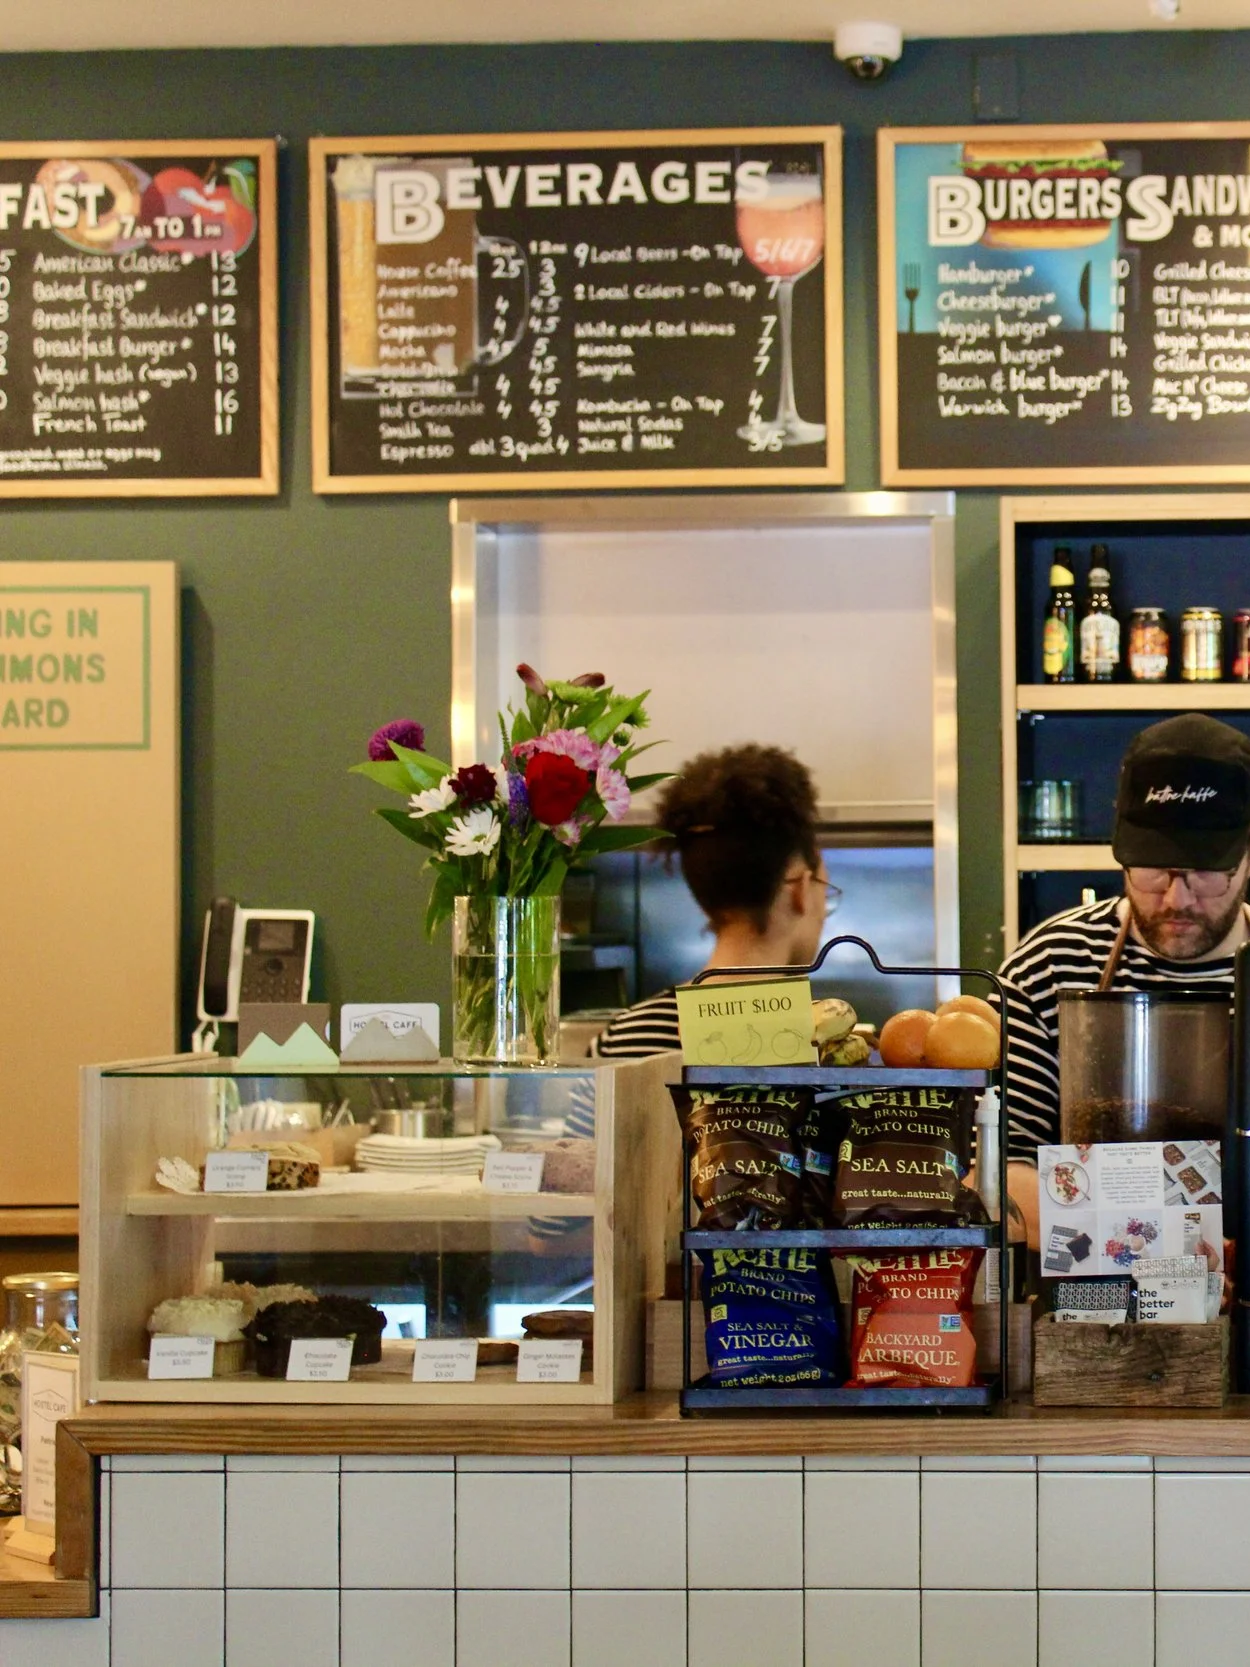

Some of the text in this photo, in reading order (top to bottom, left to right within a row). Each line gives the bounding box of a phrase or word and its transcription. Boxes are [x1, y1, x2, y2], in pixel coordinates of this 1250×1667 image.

[0, 182, 105, 230] FAST
[375, 160, 772, 245] BEVERAGES
[928, 174, 1122, 247] BURGERS
[154, 216, 183, 238] TO
[1192, 225, 1213, 247] &
[33, 251, 114, 274] American
[211, 250, 236, 272] 13
[573, 242, 590, 268] 9
[754, 236, 816, 263] 5/6/7
[212, 275, 237, 297] 12
[765, 275, 782, 300] 7
[212, 304, 236, 327] 12
[213, 332, 236, 356] 14
[937, 345, 996, 366] Salmon
[215, 361, 239, 383] 13
[937, 371, 986, 392] Bacon
[32, 389, 239, 413] Salmon 16
[1111, 394, 1133, 417] 13
[32, 412, 97, 436] French
[215, 413, 233, 435] 11
[380, 443, 454, 464] Espresso
[66, 608, 98, 638] IN
[1, 698, 69, 728] ARD
[698, 997, 792, 1018] FRUIT $1.00
[717, 1106, 761, 1115] BRAND
[874, 1109, 917, 1118] BRAND
[907, 1123, 951, 1139] CHIPS
[699, 1160, 781, 1183] SEA SALT
[851, 1158, 946, 1177] SEA SALT
[842, 1189, 868, 1199] great
[741, 1268, 785, 1282] BRAND
[882, 1273, 927, 1283] BRAND
[711, 1281, 816, 1304] POTATO CHIPS
[916, 1287, 959, 1300] CHIPS
[1139, 1288, 1158, 1298] the
[1139, 1299, 1175, 1308] better
[1062, 1313, 1078, 1321] the
[1139, 1310, 1158, 1319] bar
[727, 1322, 753, 1332] SEA
[756, 1322, 789, 1330] SALT
[719, 1333, 815, 1350] VINEGAR
[867, 1333, 942, 1346] BACKYARD
[717, 1355, 741, 1366] great
[859, 1348, 959, 1370] ARBEQUE
